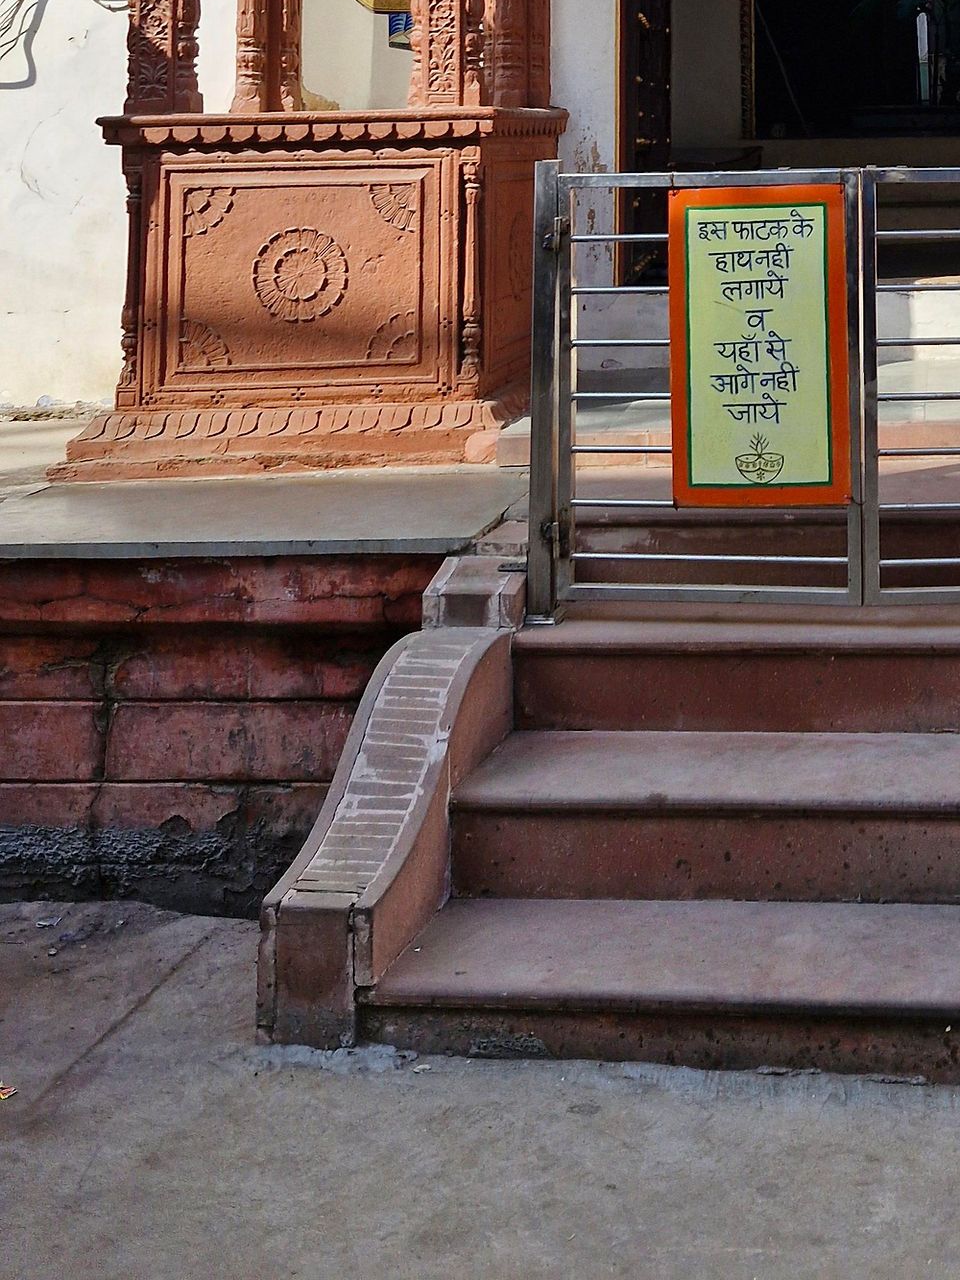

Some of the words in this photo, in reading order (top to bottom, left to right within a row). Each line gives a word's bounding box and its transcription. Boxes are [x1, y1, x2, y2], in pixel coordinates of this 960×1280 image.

[698, 220, 728, 241] इस
[731, 218, 790, 240] फाटक
[791, 209, 815, 238] के
[709, 250, 753, 273] हाथ
[754, 242, 794, 270] नहीं
[721, 270, 789, 301] लगायें
[745, 308, 773, 332] व
[764, 331, 792, 361] से
[710, 364, 759, 395] आगे
[760, 362, 800, 393] नहीं
[723, 393, 787, 424] जायें
